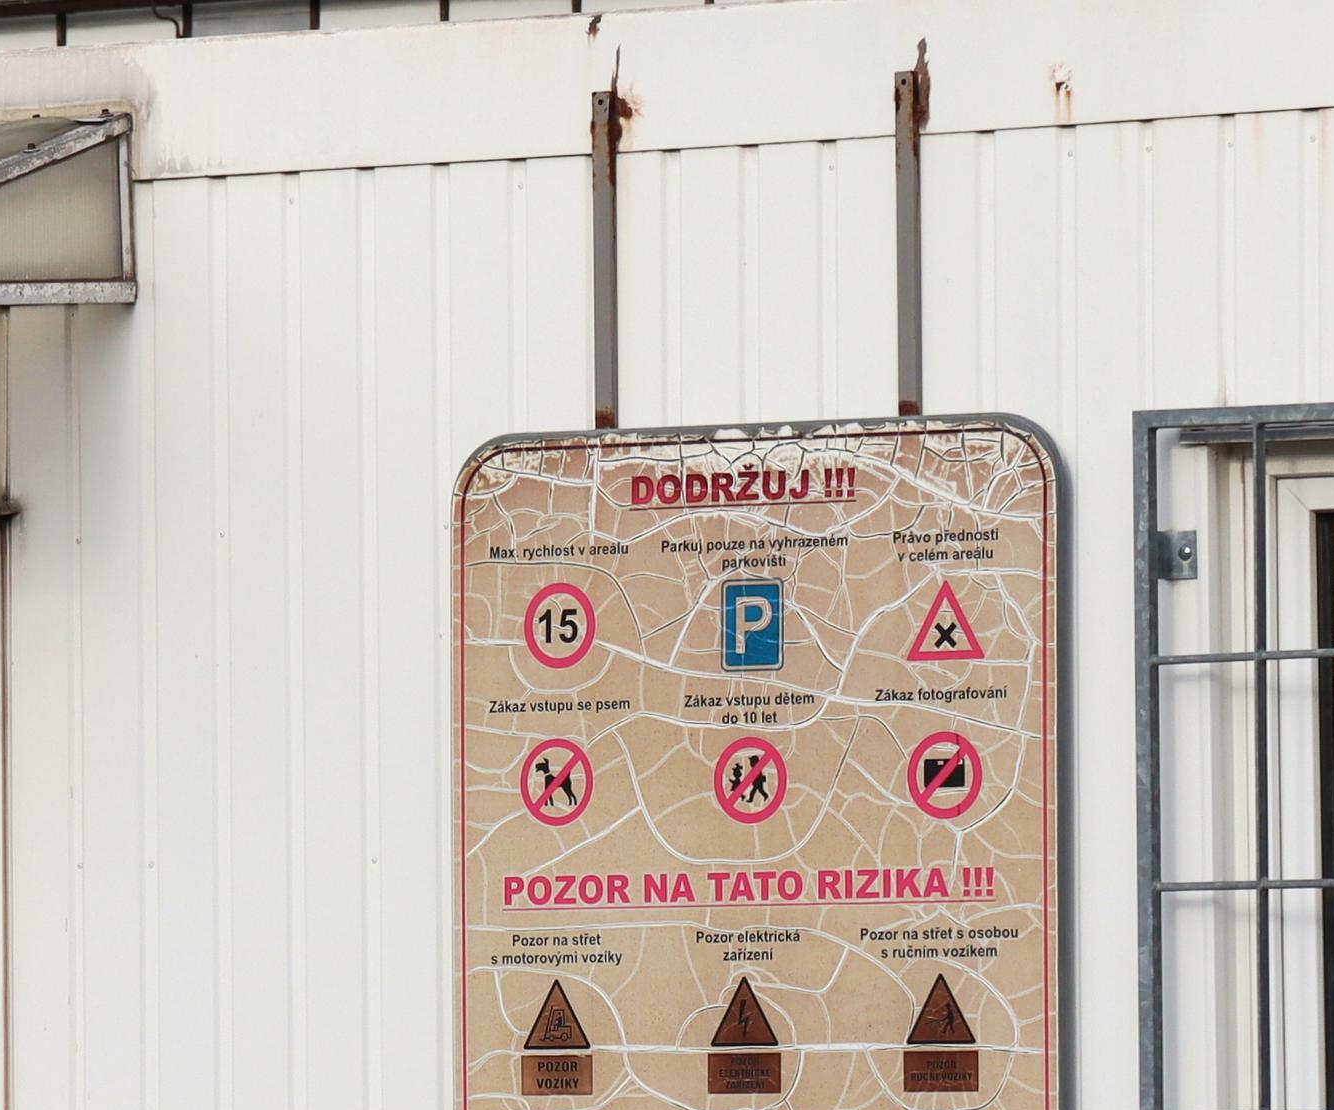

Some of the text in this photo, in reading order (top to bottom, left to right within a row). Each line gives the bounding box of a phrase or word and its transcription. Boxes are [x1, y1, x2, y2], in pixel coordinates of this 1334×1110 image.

[630, 464, 856, 506] DODRŽUJ !!!
[661, 533, 848, 554] Parkuj pouze na vyhrazeném
[893, 530, 931, 544] Právo
[489, 543, 629, 561] Max. rychlost v areálu
[897, 546, 994, 562] v celém areálu
[538, 608, 579, 644] 15
[735, 596, 773, 655] P
[684, 692, 815, 709] Zákaz vstupu dětem
[875, 685, 1007, 705] Zákaz fotografování
[489, 700, 630, 716] Zákaz vstupu se psem
[722, 711, 777, 725] do 10 let
[503, 866, 995, 906] POZOR NA TATO RIZIKA !!!
[512, 932, 601, 947] Pozor na střet
[696, 929, 801, 944] Pozor elektrická
[860, 925, 1019, 941] Pozor na střet s osobou
[490, 954, 498, 965] s
[502, 950, 578, 967] motorovými
[722, 947, 774, 962] zařízení
[880, 944, 998, 959] s ručním vozíkem
[537, 1061, 579, 1072] POZOR
